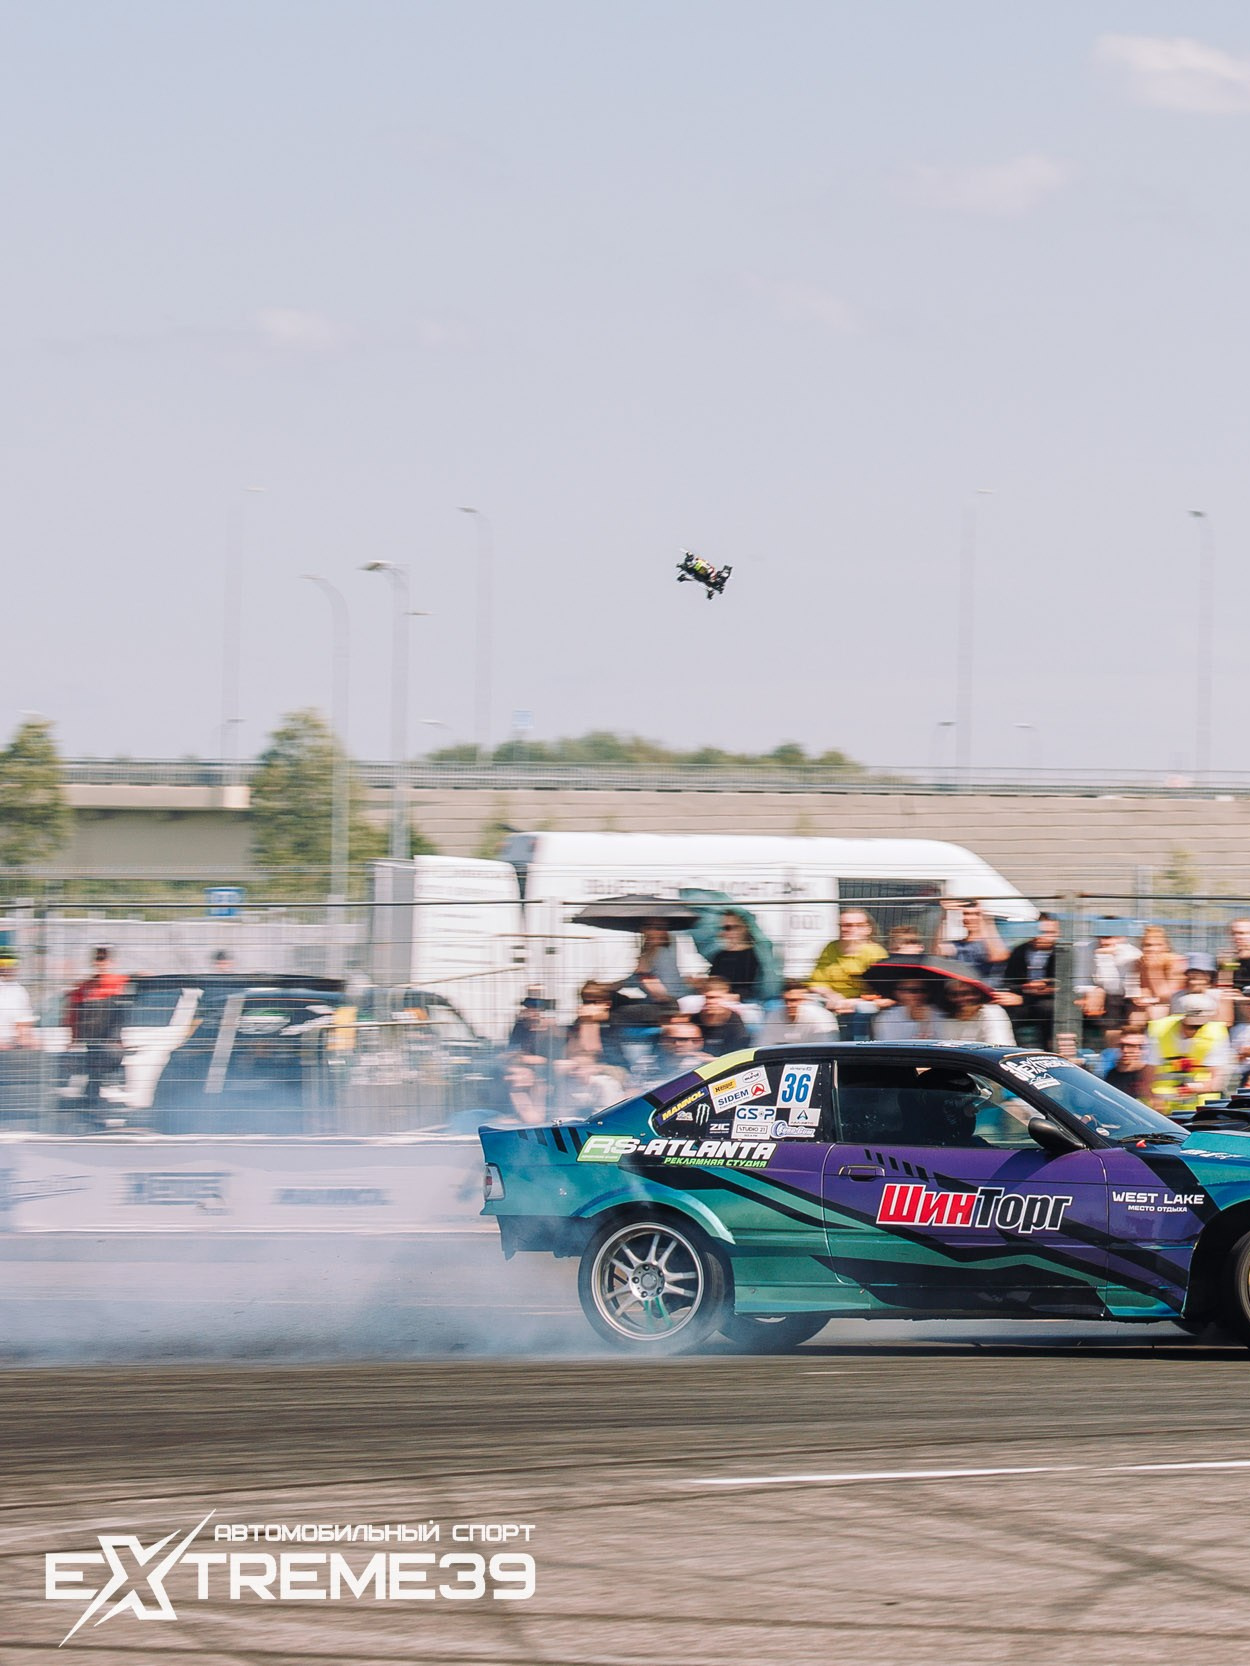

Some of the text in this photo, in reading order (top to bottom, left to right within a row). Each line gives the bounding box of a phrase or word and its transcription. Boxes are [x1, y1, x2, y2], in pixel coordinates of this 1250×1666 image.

[781, 1073, 811, 1103] 36
[662, 1090, 705, 1120] MANNOL
[718, 1090, 749, 1106] SIDEM
[709, 1123, 730, 1131] ZIC
[664, 1157, 767, 1168] РЕКЛАМНАЯ СТУДИЯ
[1112, 1191, 1204, 1204] WEST LAKE
[876, 1183, 1072, 1233] ШинТорг
